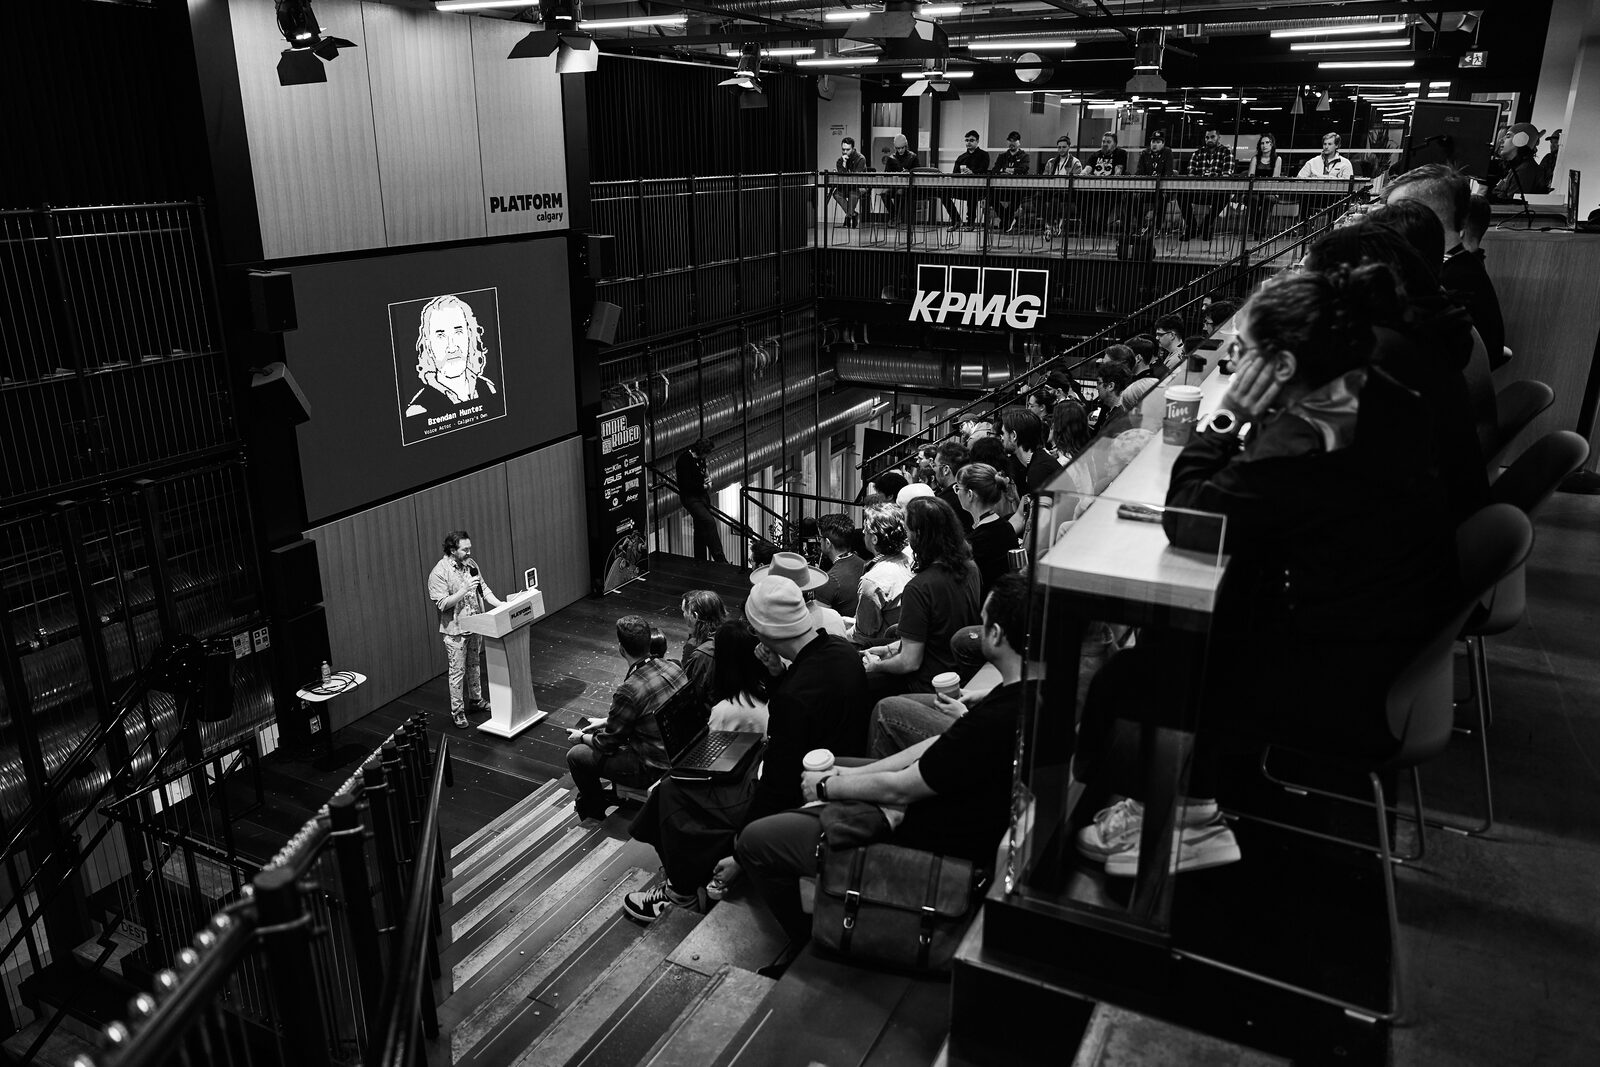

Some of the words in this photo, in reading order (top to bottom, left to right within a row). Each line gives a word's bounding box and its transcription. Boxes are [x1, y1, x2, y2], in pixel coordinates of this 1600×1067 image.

[490, 192, 563, 213] PLATFORM
[536, 211, 563, 223] calgary
[908, 289, 1042, 329] KPMG
[427, 412, 457, 426] Brendan
[459, 405, 483, 417] Hunter
[602, 417, 625, 437] INDIE
[611, 427, 639, 448] RODEO
